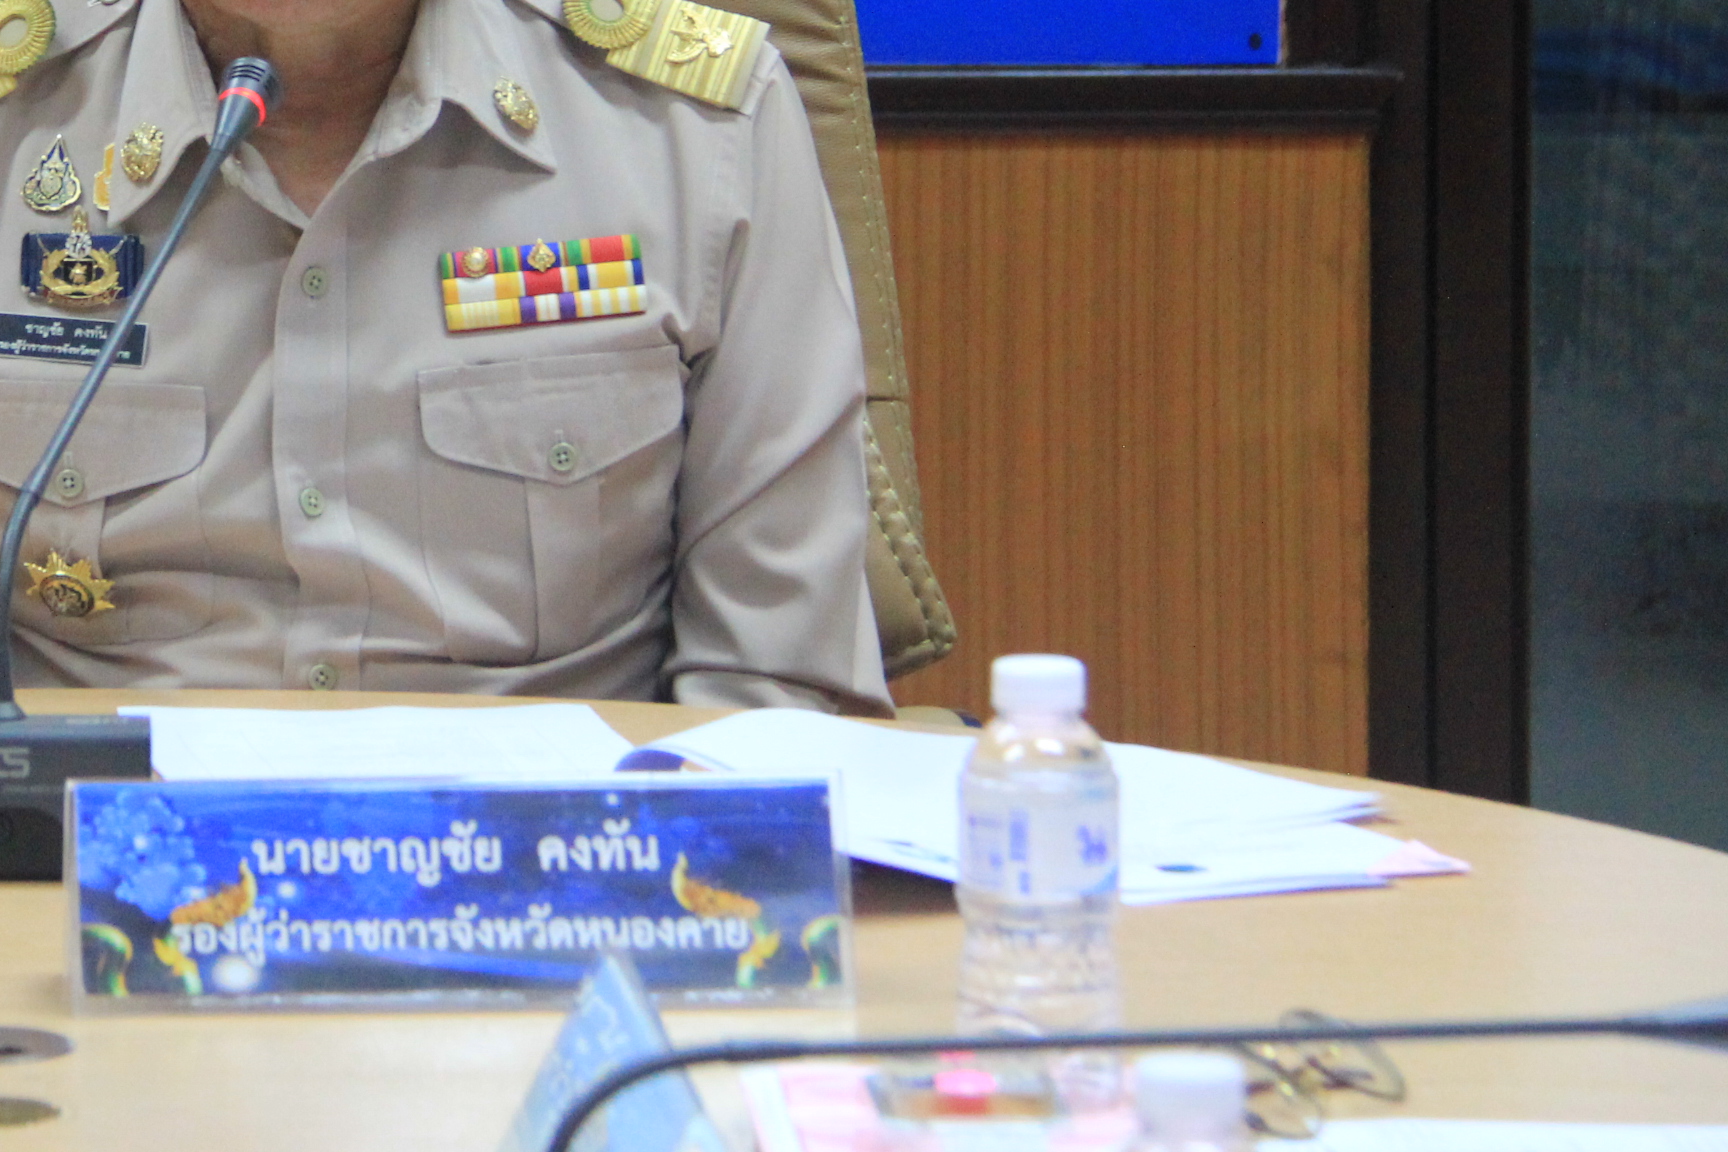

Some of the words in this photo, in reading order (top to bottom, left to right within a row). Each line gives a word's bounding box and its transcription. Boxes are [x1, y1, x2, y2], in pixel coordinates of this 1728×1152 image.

[250, 819, 503, 887] นายชาญชัย
[536, 819, 660, 873] คงทัน
[170, 904, 750, 966] รองผู้ว่าราชการจังหวัดหนองคาย
